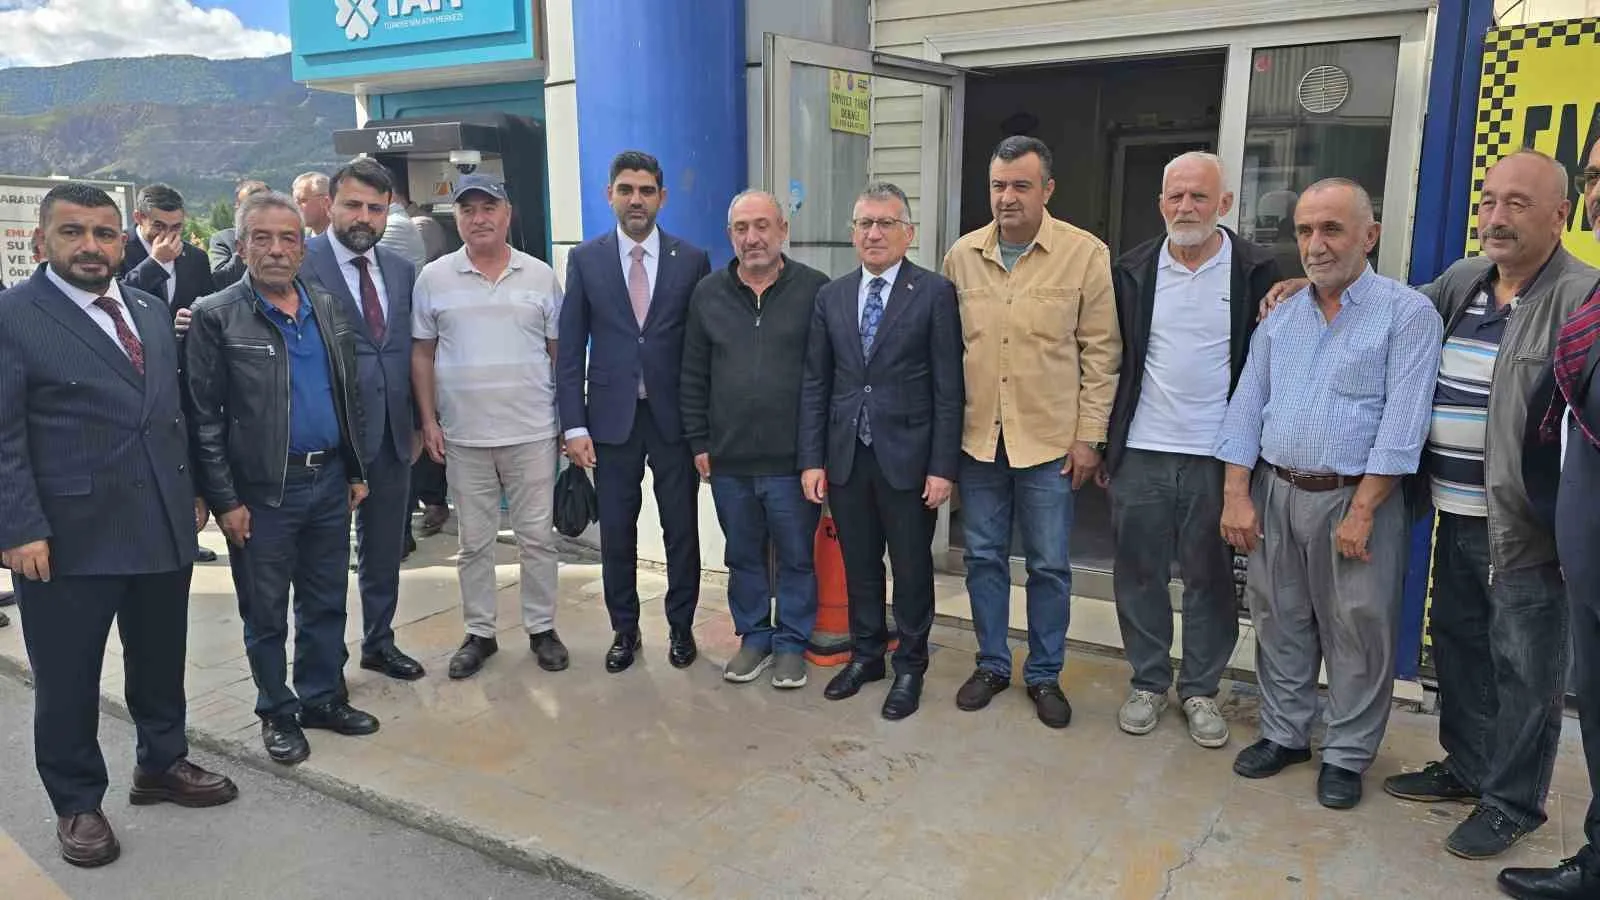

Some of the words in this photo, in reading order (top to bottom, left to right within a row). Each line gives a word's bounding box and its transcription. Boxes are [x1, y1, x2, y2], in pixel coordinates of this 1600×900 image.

[389, 130, 413, 144] TAM
[7, 241, 25, 250] SU
[8, 255, 25, 264] VE
